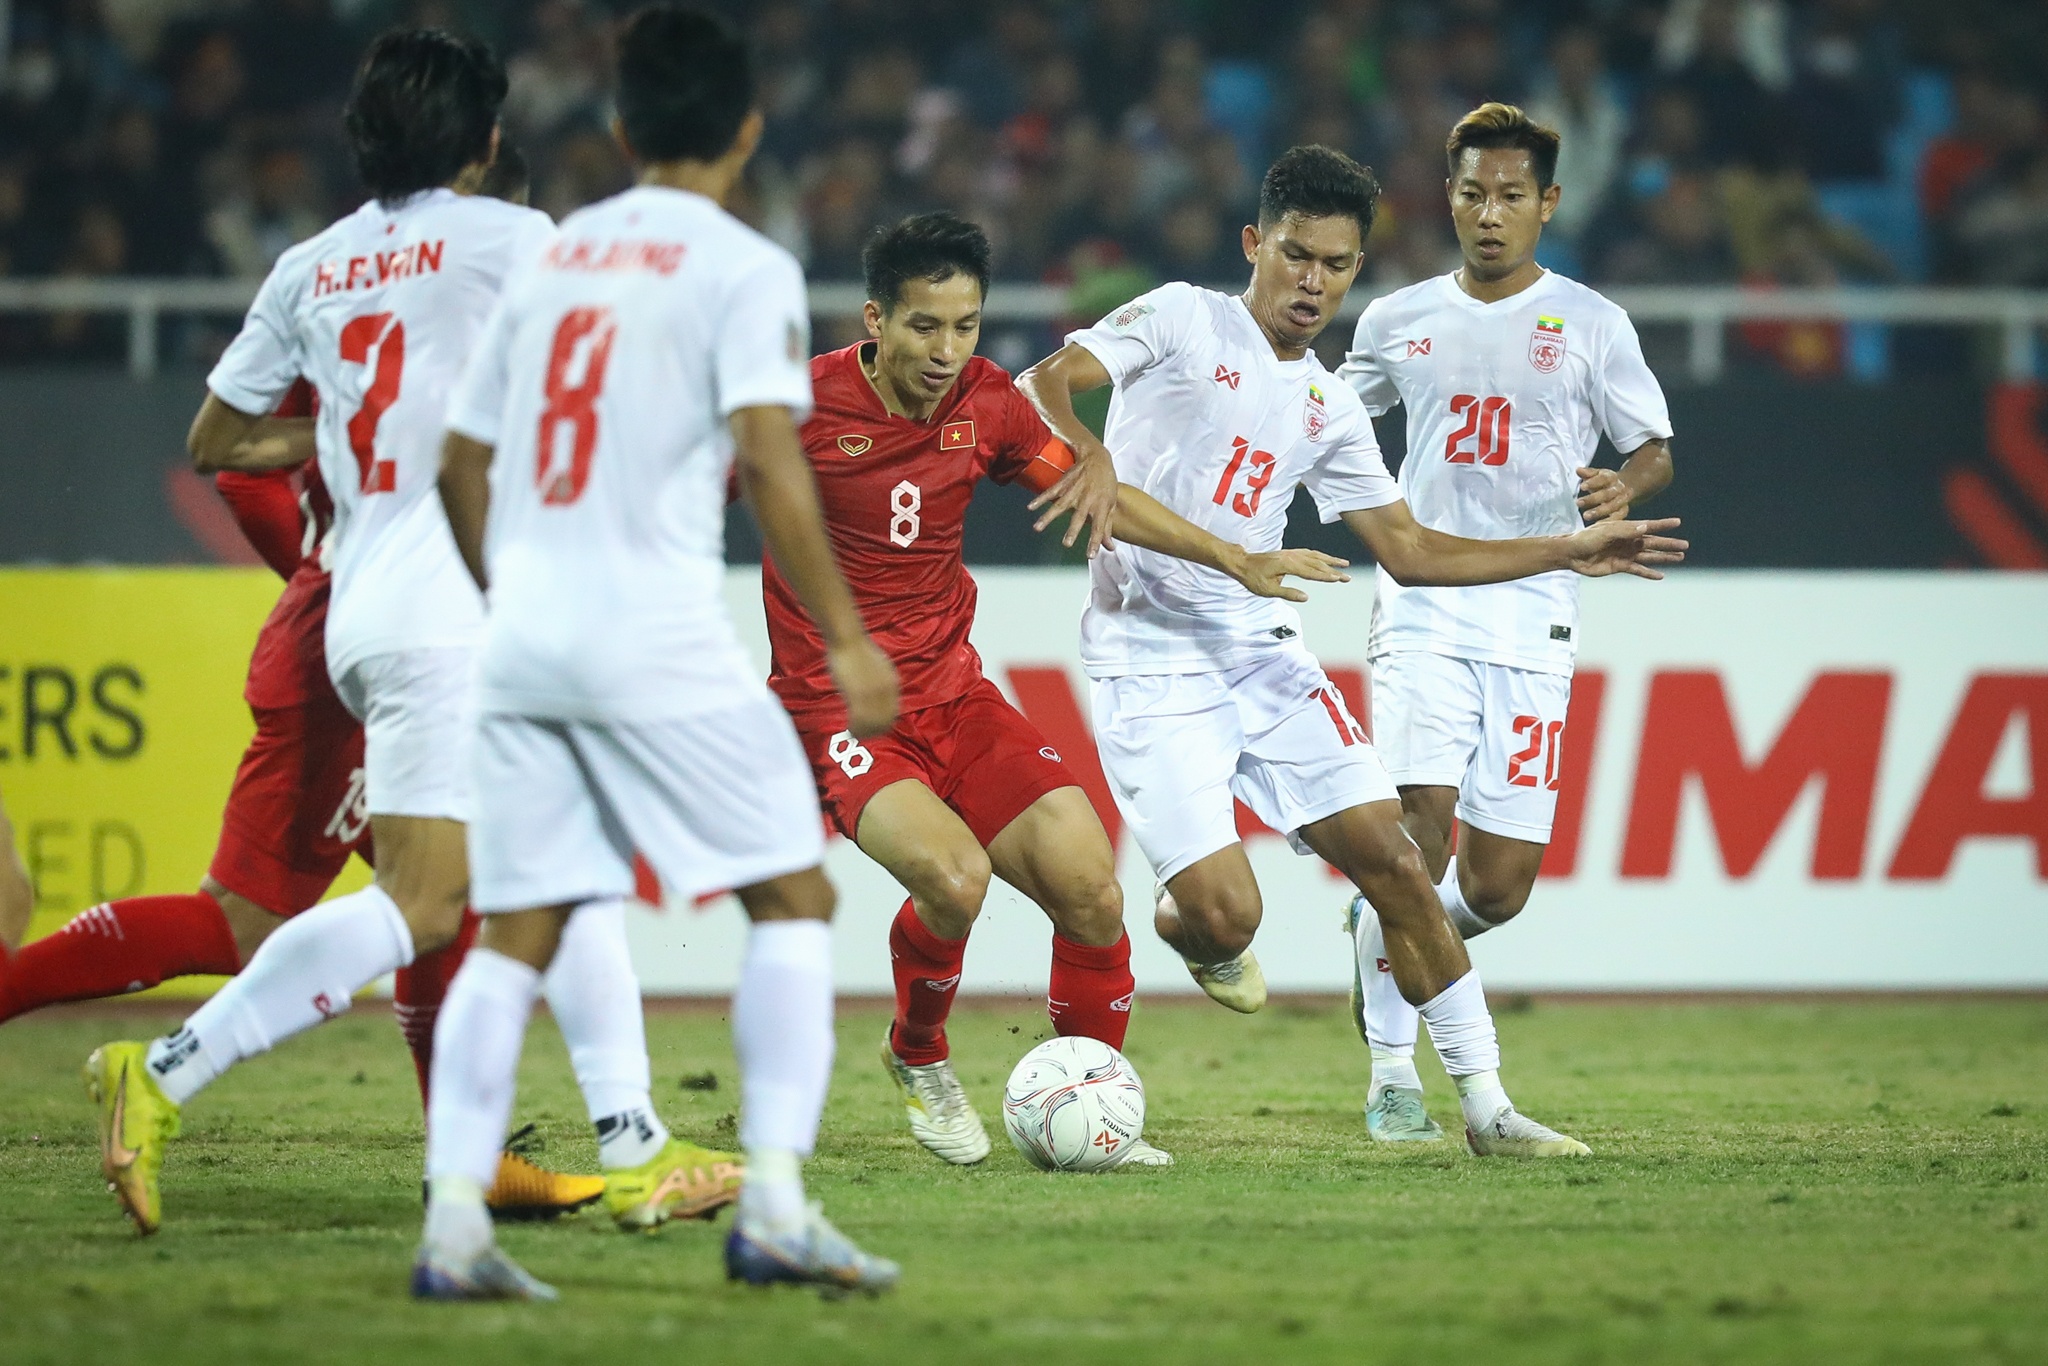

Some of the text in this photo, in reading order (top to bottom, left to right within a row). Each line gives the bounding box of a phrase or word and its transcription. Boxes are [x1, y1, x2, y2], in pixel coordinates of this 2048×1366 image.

[340, 311, 406, 496] 2
[533, 306, 617, 507] 8
[1445, 394, 1511, 466] 20
[1212, 435, 1277, 518] 13
[890, 479, 922, 549] 8
[0, 662, 147, 760] RS
[1308, 687, 1371, 748] 1
[828, 729, 874, 779] 8
[1099, 1115, 1130, 1140] WARRIX
